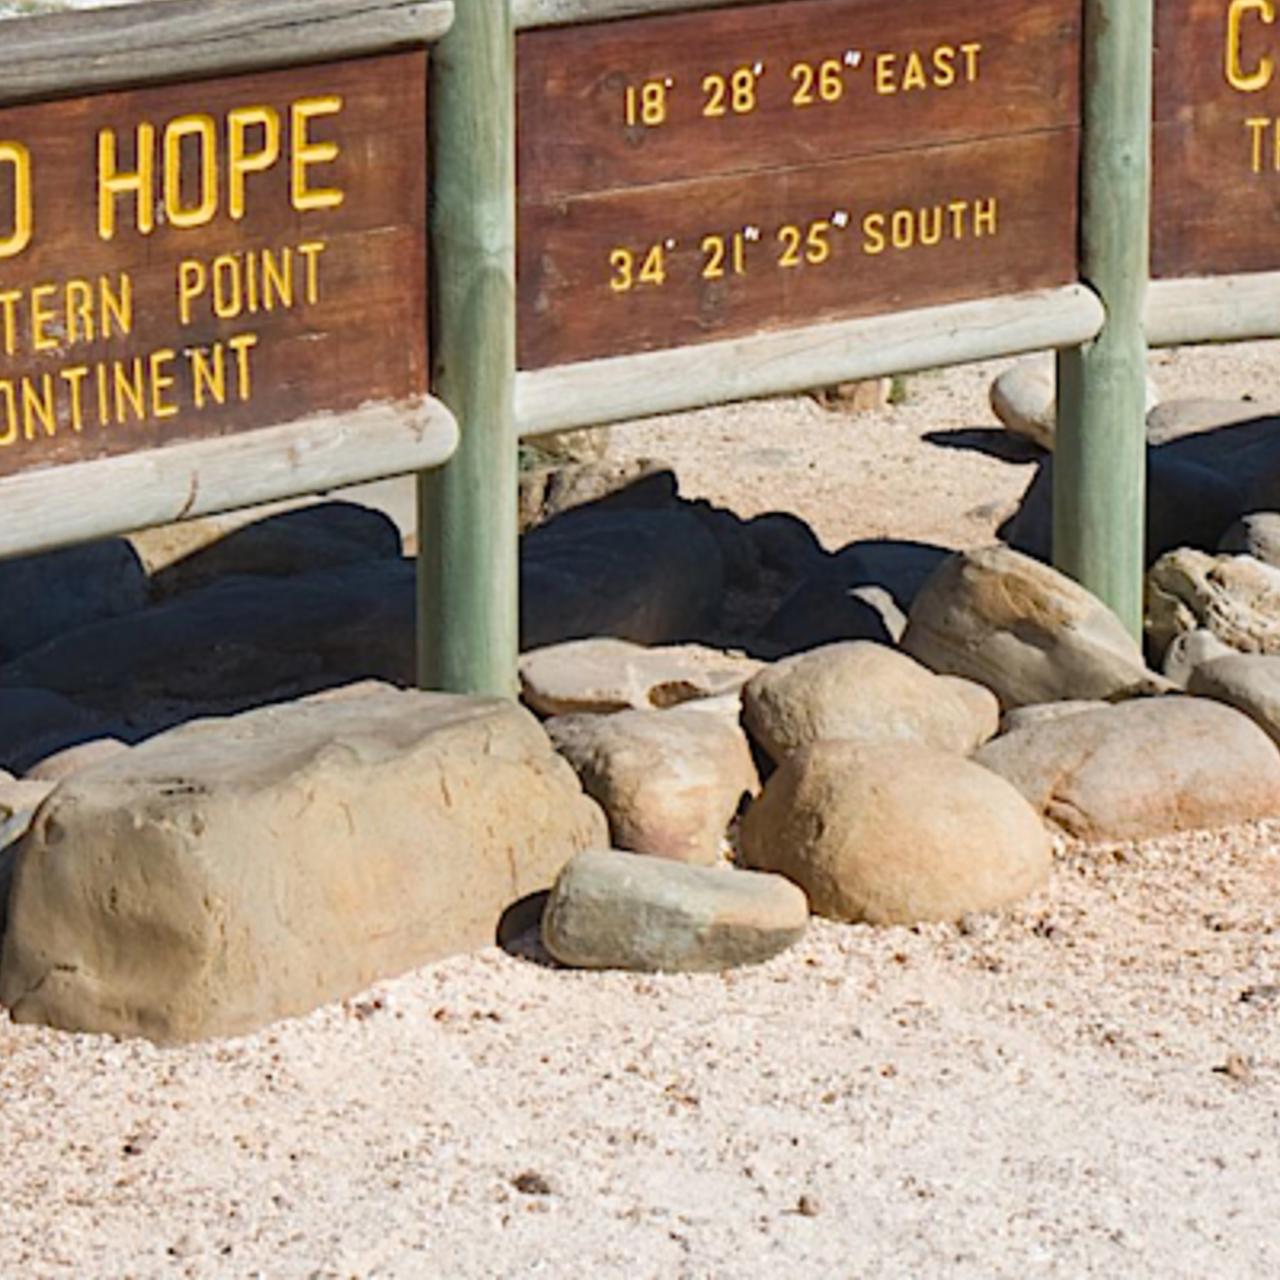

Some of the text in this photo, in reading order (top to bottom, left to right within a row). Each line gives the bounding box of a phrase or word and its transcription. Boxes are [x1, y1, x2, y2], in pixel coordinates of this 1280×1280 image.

[875, 42, 983, 96] EAST
[97, 95, 346, 242] HOPE
[862, 196, 997, 255] SOUTH
[177, 240, 326, 326] POINT
